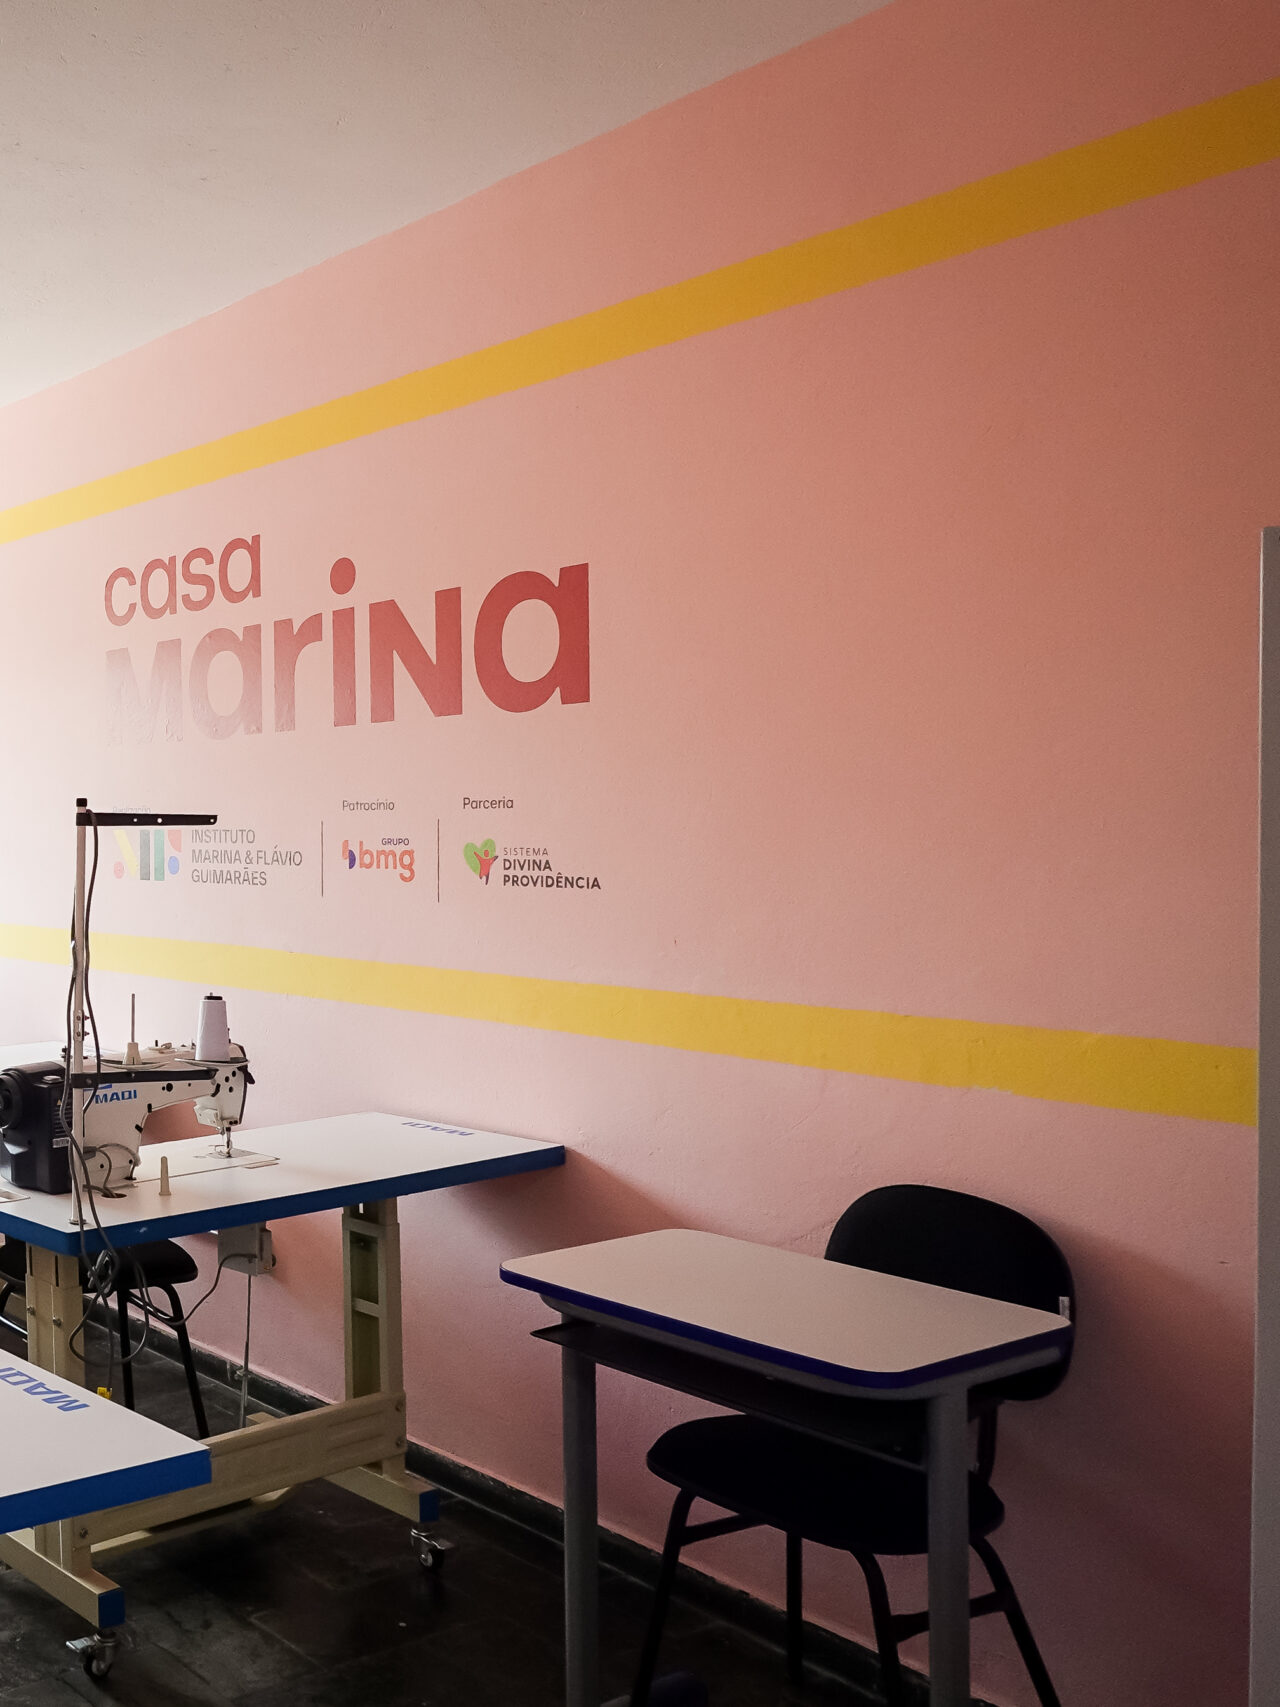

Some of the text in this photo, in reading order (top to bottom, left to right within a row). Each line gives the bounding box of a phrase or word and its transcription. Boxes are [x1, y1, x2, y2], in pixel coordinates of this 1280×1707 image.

[105, 534, 261, 627] casa
[342, 799, 395, 811] Patrocínio
[463, 796, 514, 810] Parceria
[191, 829, 256, 844] INSTITUTO
[381, 838, 410, 846] GRUPO
[191, 844, 302, 866] MARINA & FLÁVIO
[503, 847, 549, 857] SISTEMA
[503, 859, 552, 872] DIVINA
[191, 867, 267, 886] GUIMARÃES
[503, 873, 601, 890] PROVIDÊNCIA
